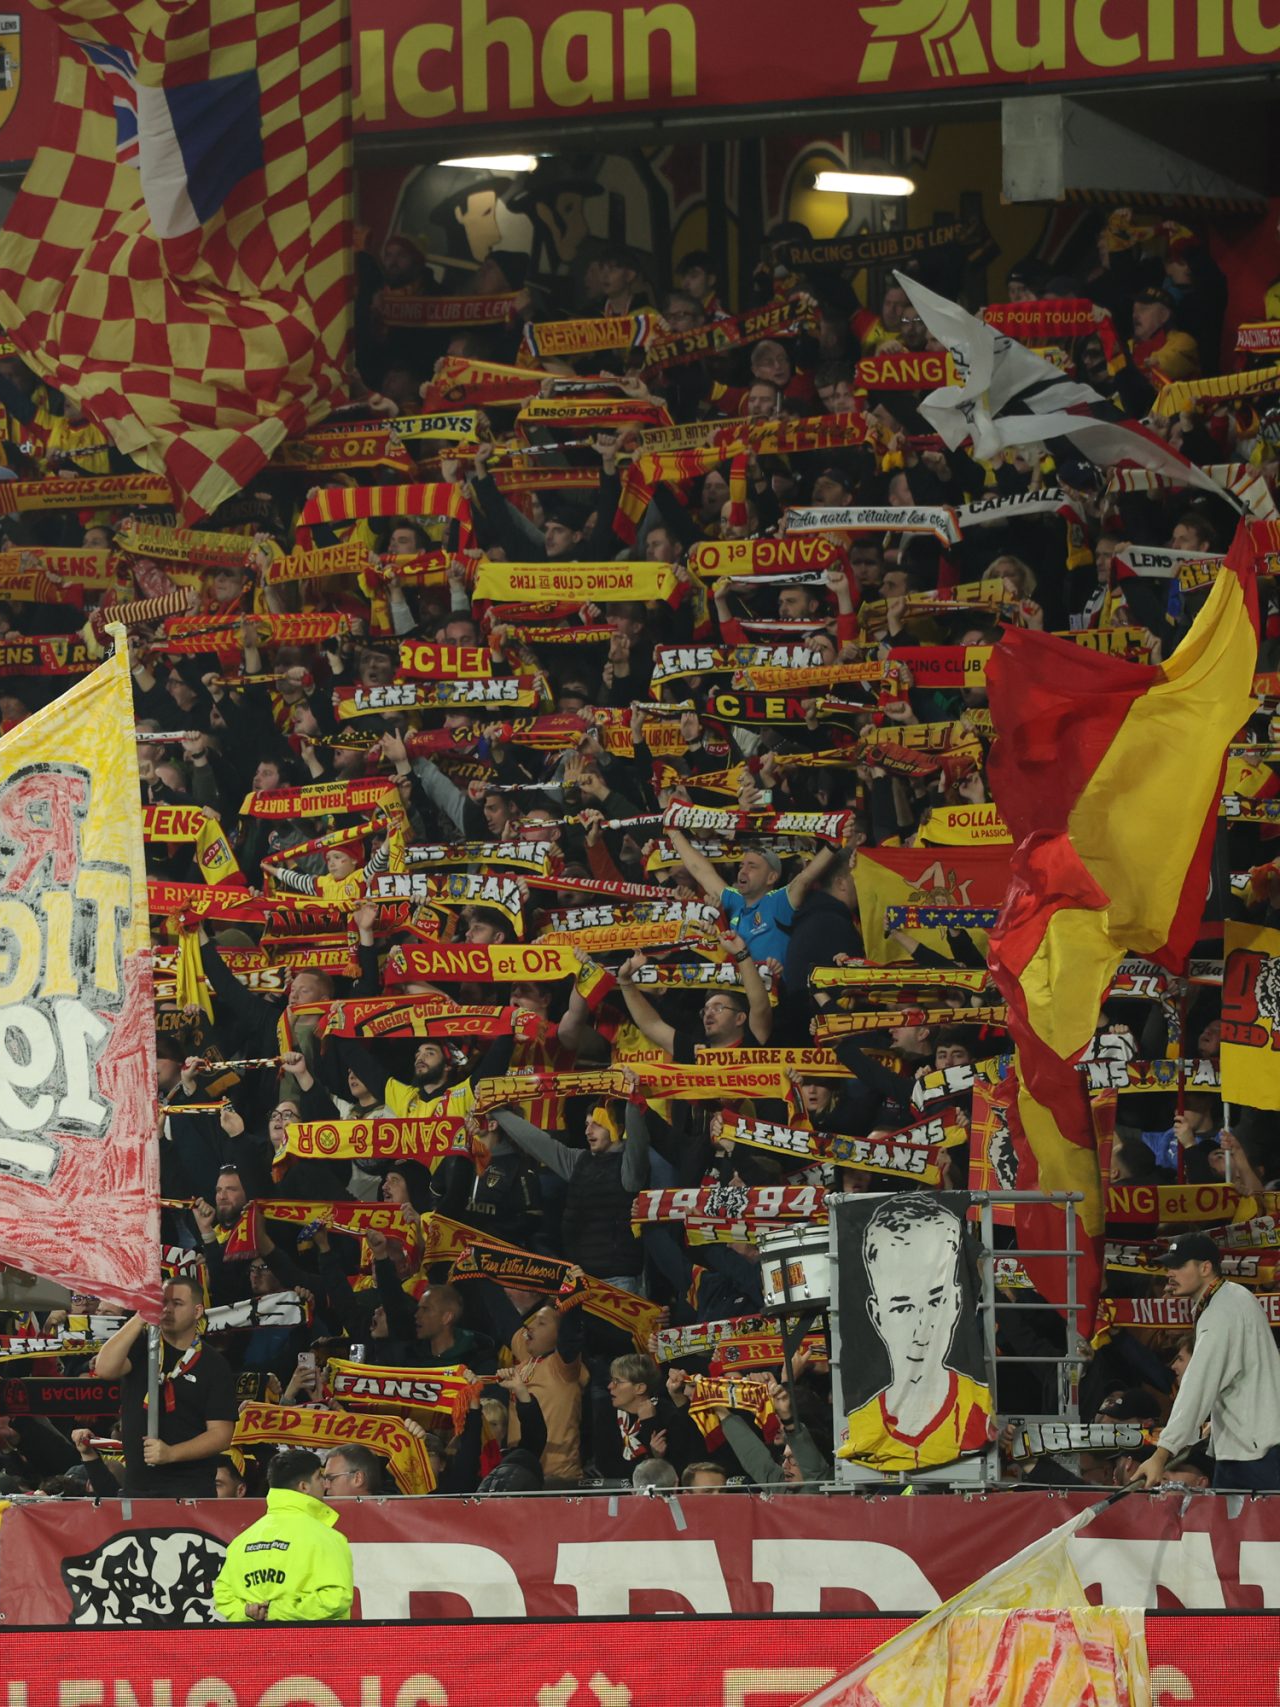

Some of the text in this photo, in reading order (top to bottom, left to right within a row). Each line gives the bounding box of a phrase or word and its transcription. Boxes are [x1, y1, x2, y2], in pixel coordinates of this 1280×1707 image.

[0, 21, 17, 31] LENS
[857, 235, 898, 260] CLUB
[1007, 312, 1046, 325] POUR
[542, 323, 626, 348] GERMINAL
[859, 359, 942, 390] SANG
[421, 416, 474, 436] BOYS
[527, 406, 577, 418] LENSOIS
[343, 440, 376, 458] OR
[969, 488, 1066, 515] CAPITALE
[1129, 552, 1173, 572] LENS
[400, 645, 434, 676] RC
[945, 660, 982, 679] CLUB
[361, 678, 520, 710] LENS FANS
[143, 810, 204, 843] LENS
[466, 869, 525, 918] FANS
[269, 908, 343, 936] ALLEZ
[553, 900, 722, 932] LENS FANS
[417, 949, 562, 979] SANG et OR
[445, 1018, 496, 1036] RCL
[664, 1064, 782, 1086] D'ÊTRE LENSOIS
[378, 1120, 454, 1153] SANG
[736, 1118, 930, 1175] LENS FANS
[645, 1187, 699, 1220] 19
[752, 1187, 819, 1218] 94
[1165, 1185, 1240, 1214] et OR
[335, 1378, 442, 1405] FANS
[242, 1410, 411, 1452] RED TIGERS
